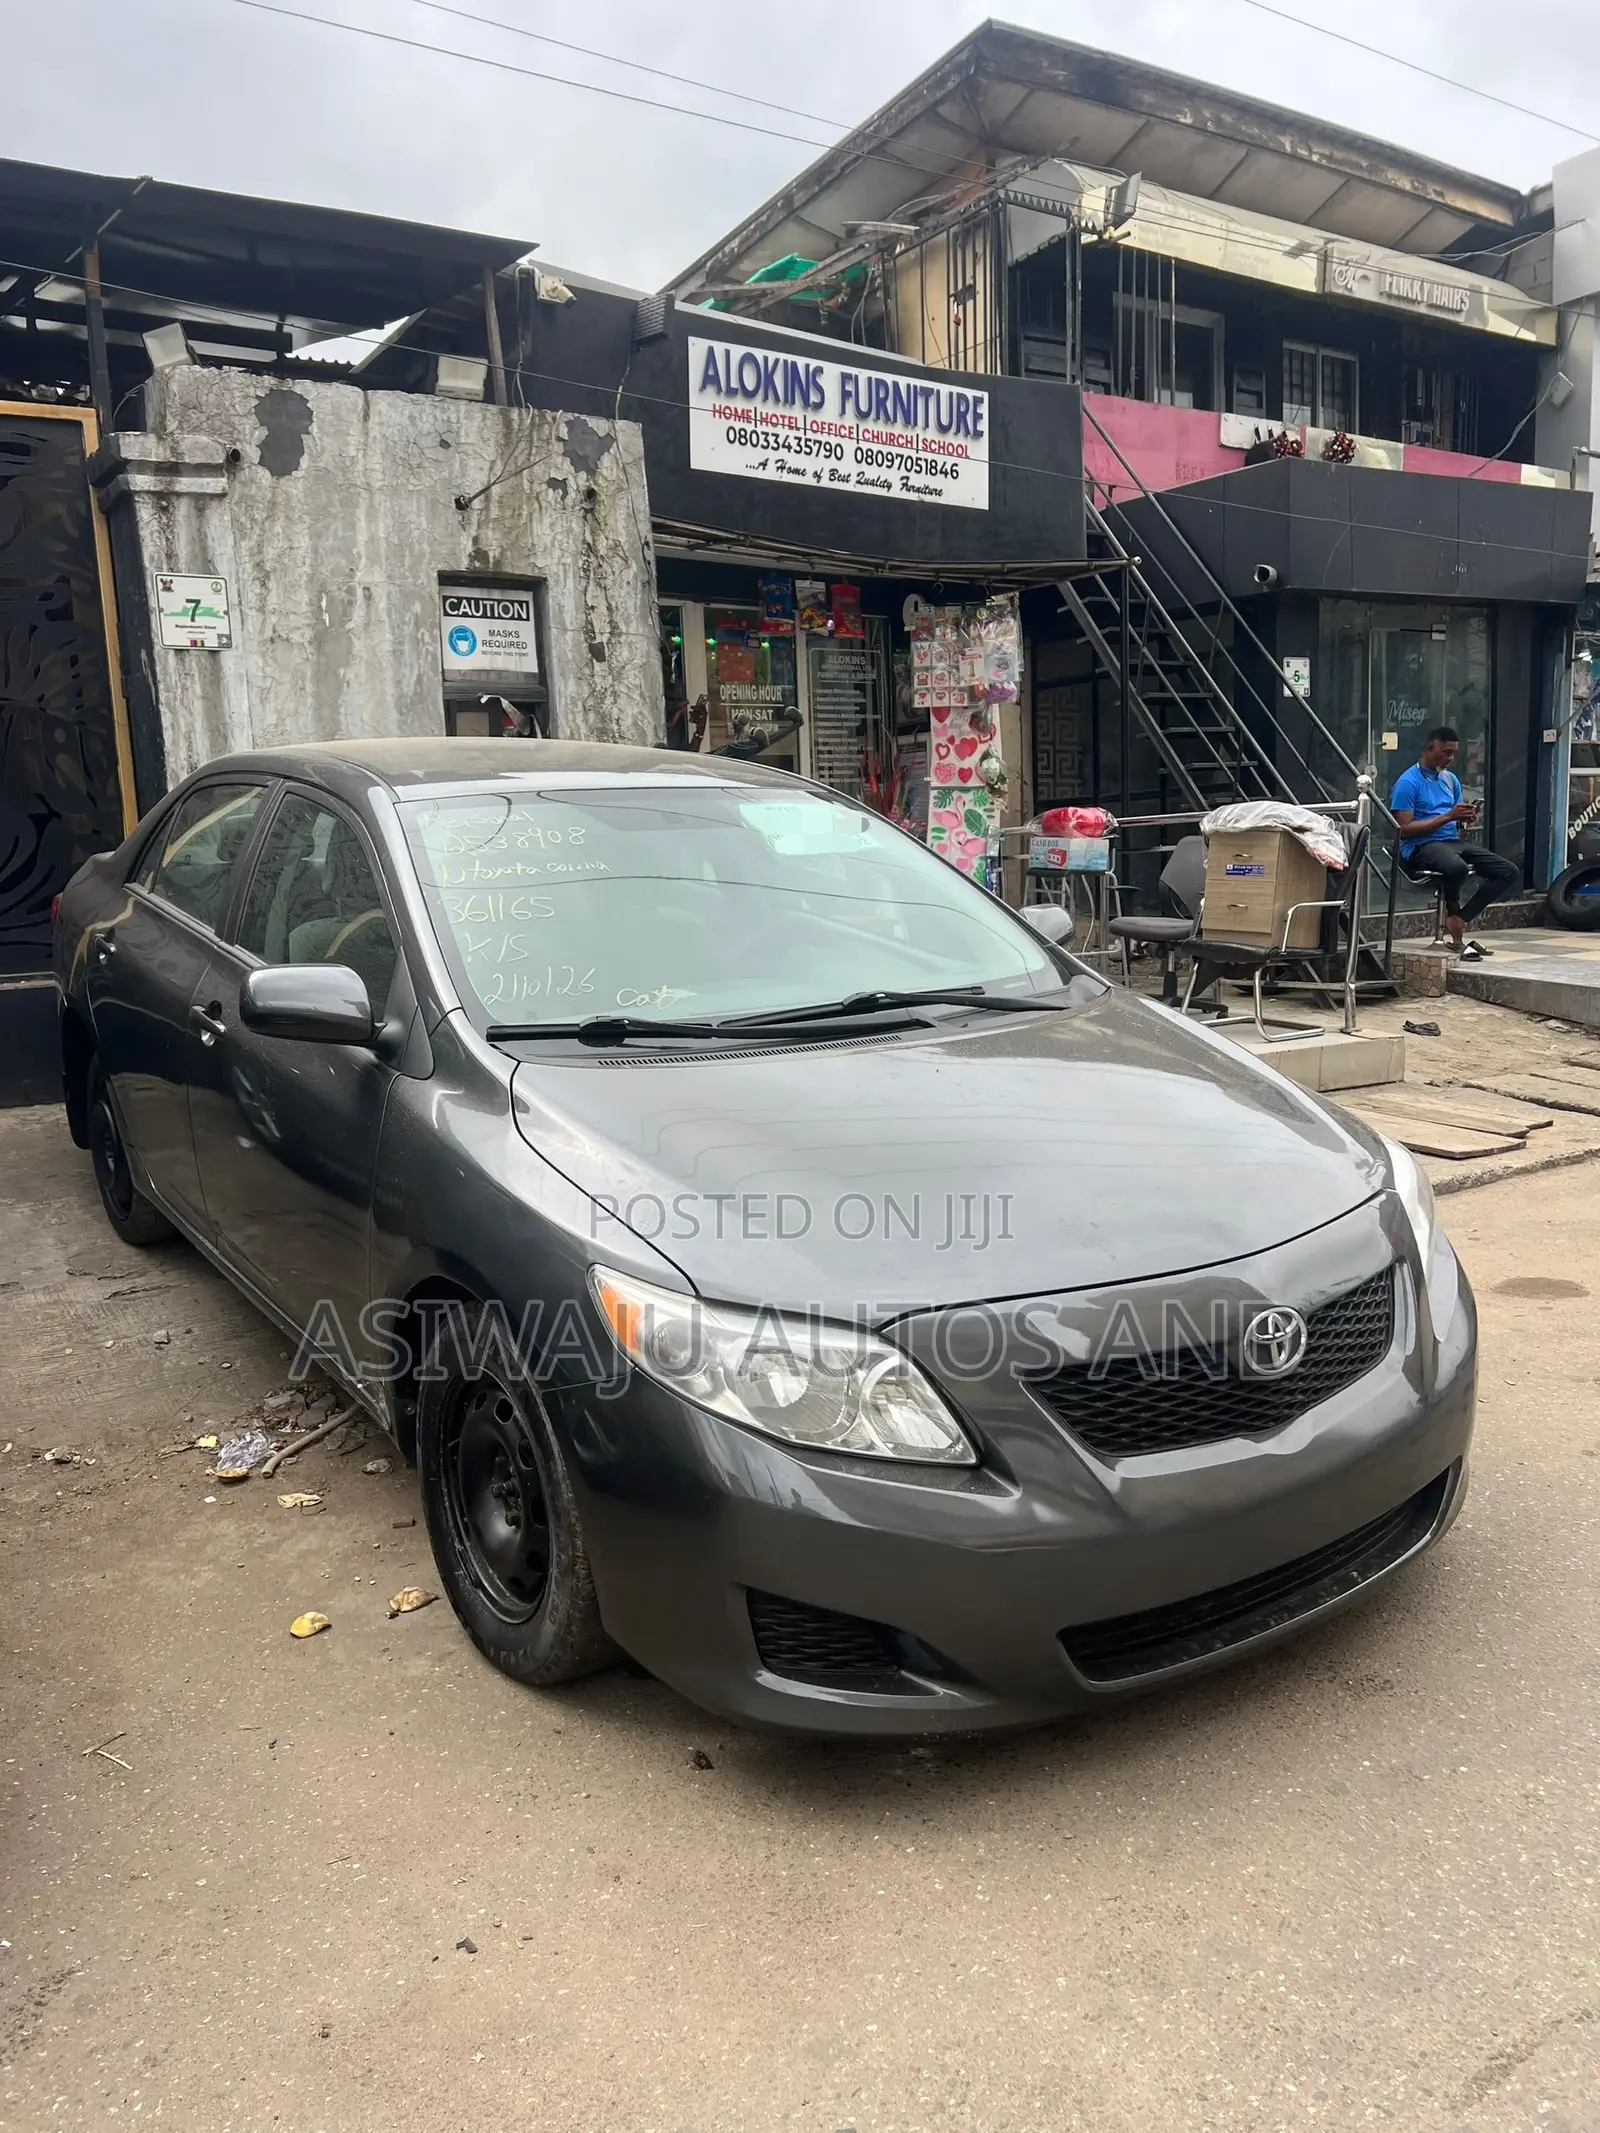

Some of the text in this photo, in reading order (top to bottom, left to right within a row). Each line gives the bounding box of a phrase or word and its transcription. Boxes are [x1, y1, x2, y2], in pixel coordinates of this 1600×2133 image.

[699, 345, 984, 438] ALOKINS FURNITURE
[712, 403, 969, 458] HOME HOTEL OFFICE CHURCH SCHOOL
[726, 426, 960, 480] 08033435790 08097051846
[774, 458, 807, 477] Home
[812, 467, 825, 483] of
[828, 468, 852, 484] Best
[855, 471, 893, 492] Quality
[899, 475, 944, 497] Furniture
[185, 598, 201, 622] 7
[445, 598, 527, 619] CAUTION
[488, 629, 520, 638] MASKS
[481, 640, 528, 649] REQUIRED
[827, 654, 866, 665] ALOKINS
[1293, 670, 1300, 683] 5
[720, 684, 782, 701] OPENING HOUR
[1031, 839, 1060, 847] CASH BOX
